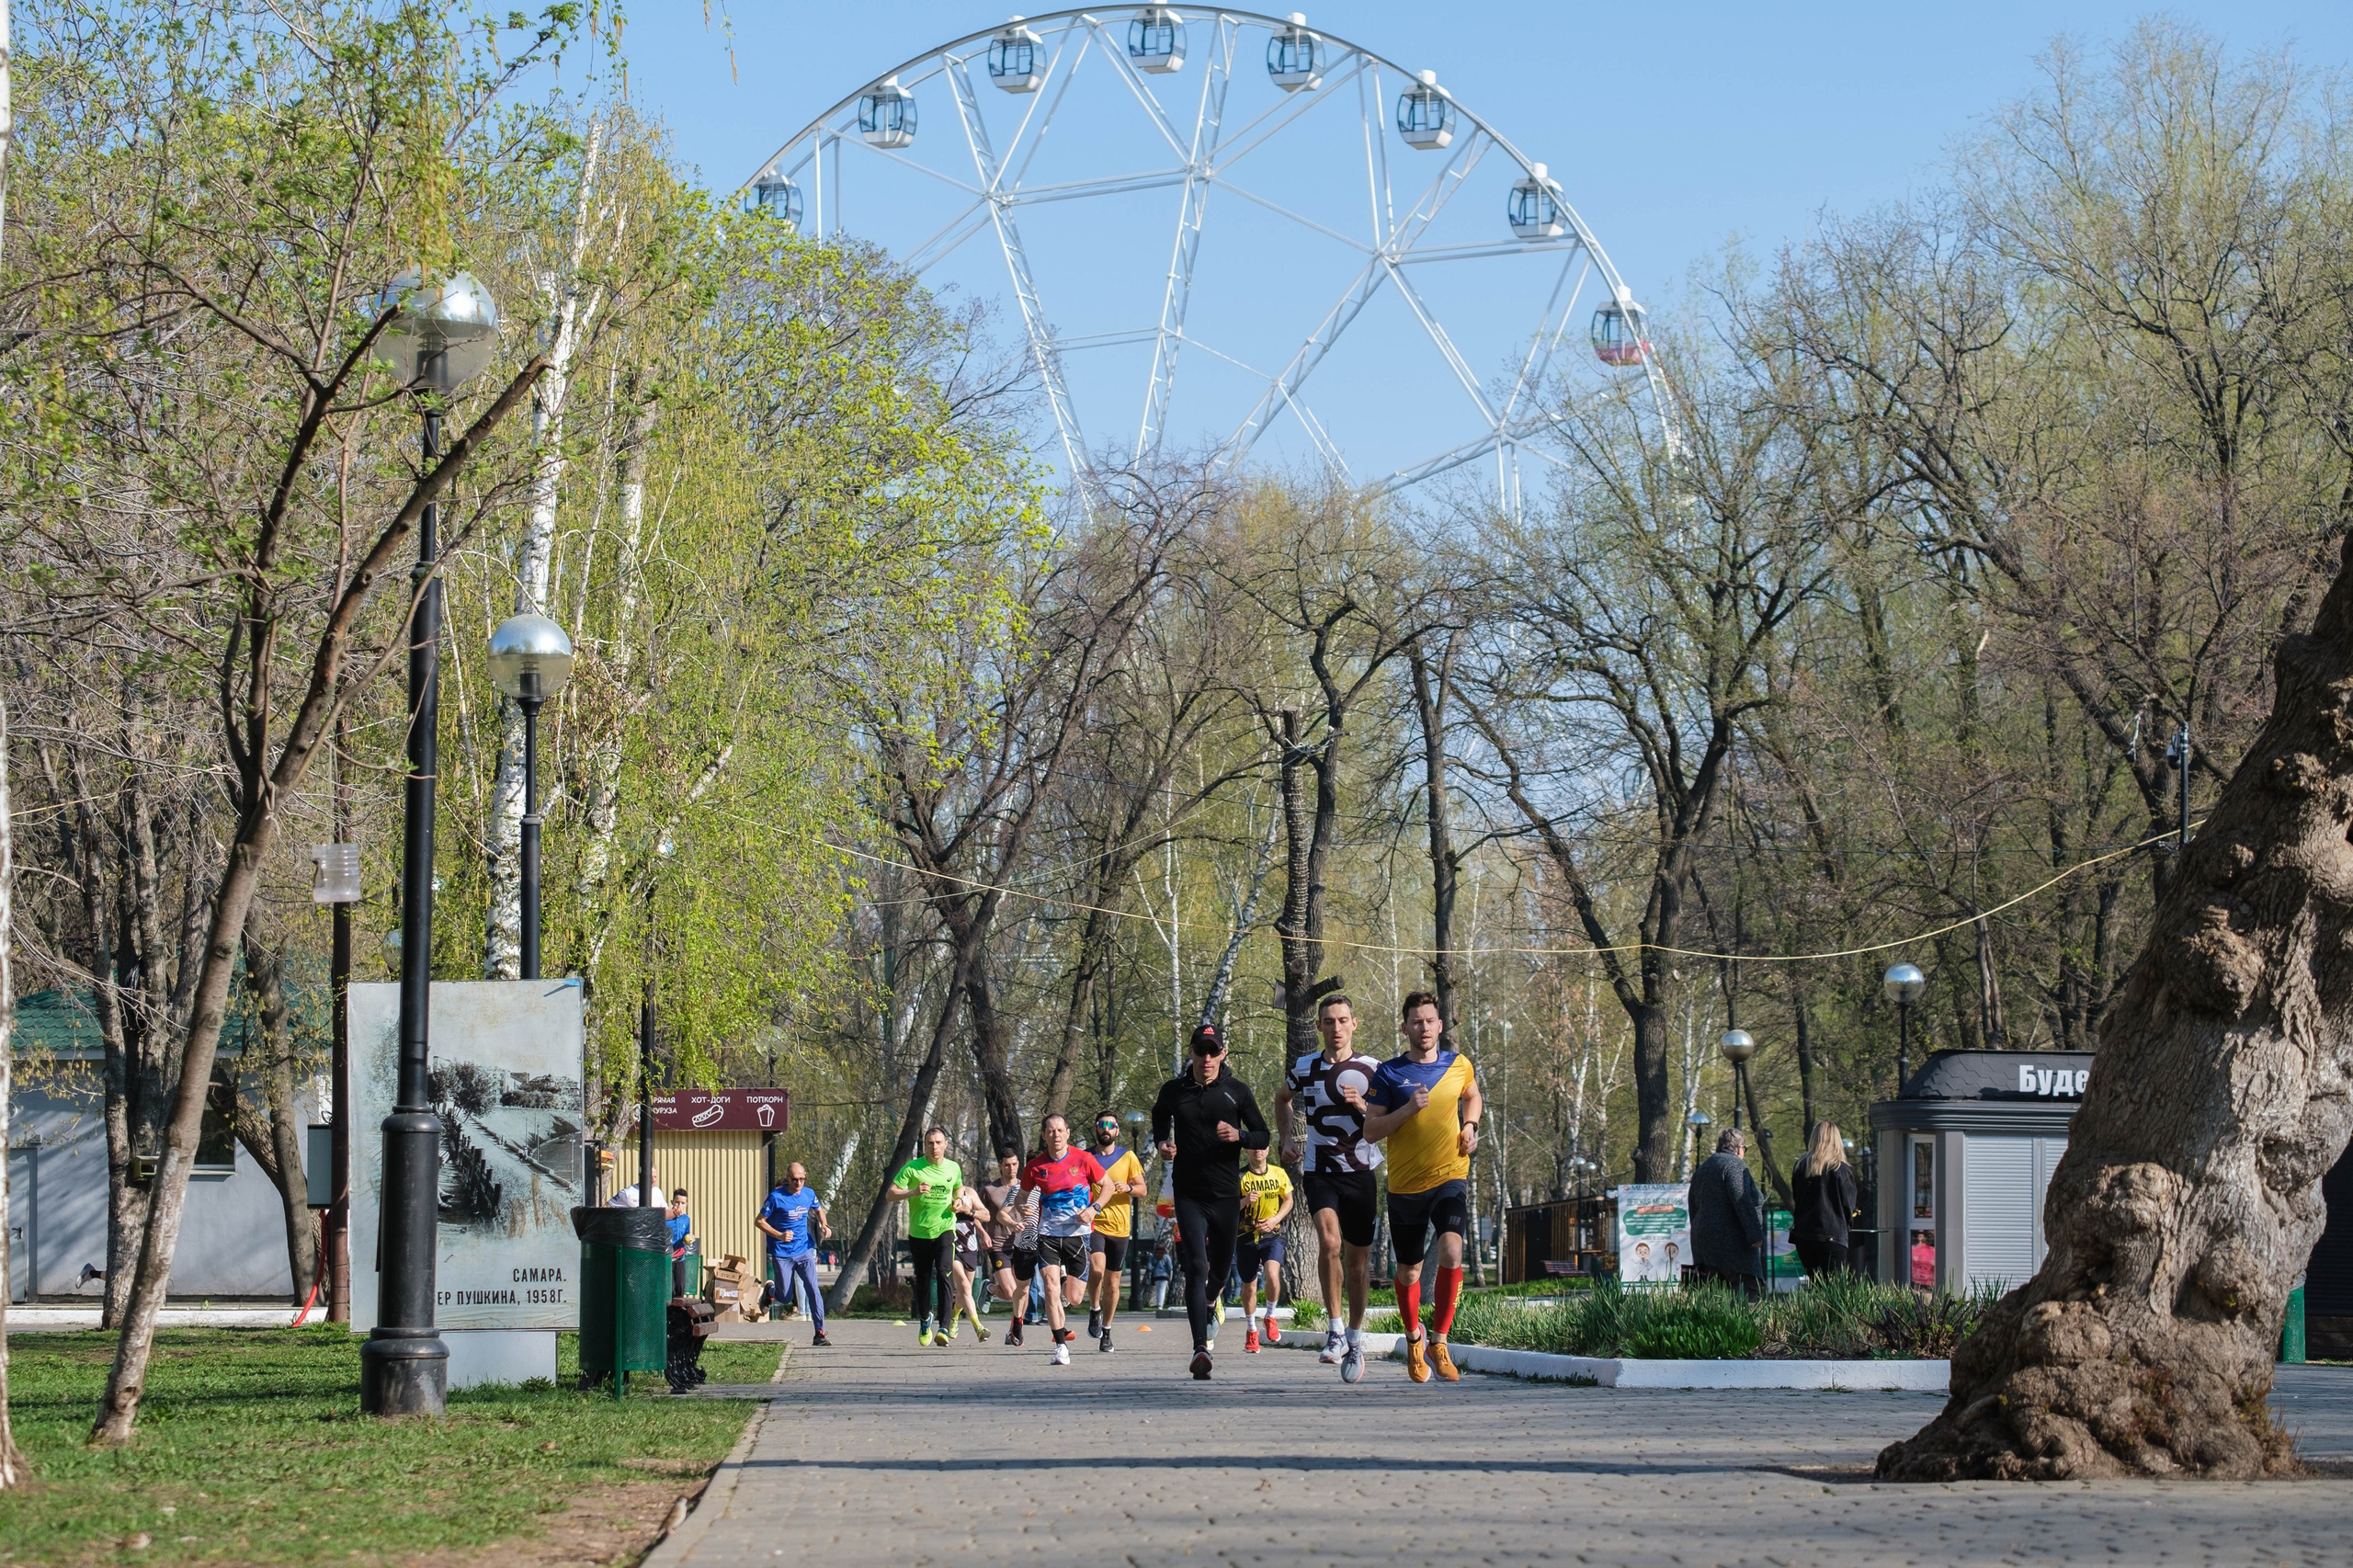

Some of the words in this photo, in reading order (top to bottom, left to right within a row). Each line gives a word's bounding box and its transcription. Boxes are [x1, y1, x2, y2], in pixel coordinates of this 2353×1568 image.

[2018, 1064, 2090, 1097] Буде
[691, 1096, 731, 1105] ХОТ-ДОГИ
[746, 1096, 783, 1104] ПОПКОРН
[1244, 1178, 1279, 1193] SAMARA
[513, 1267, 567, 1283] САМАРА.
[438, 1290, 451, 1305] ЕР
[457, 1290, 520, 1306] ПУШКИНА,
[527, 1289, 567, 1303] 1958Г.
